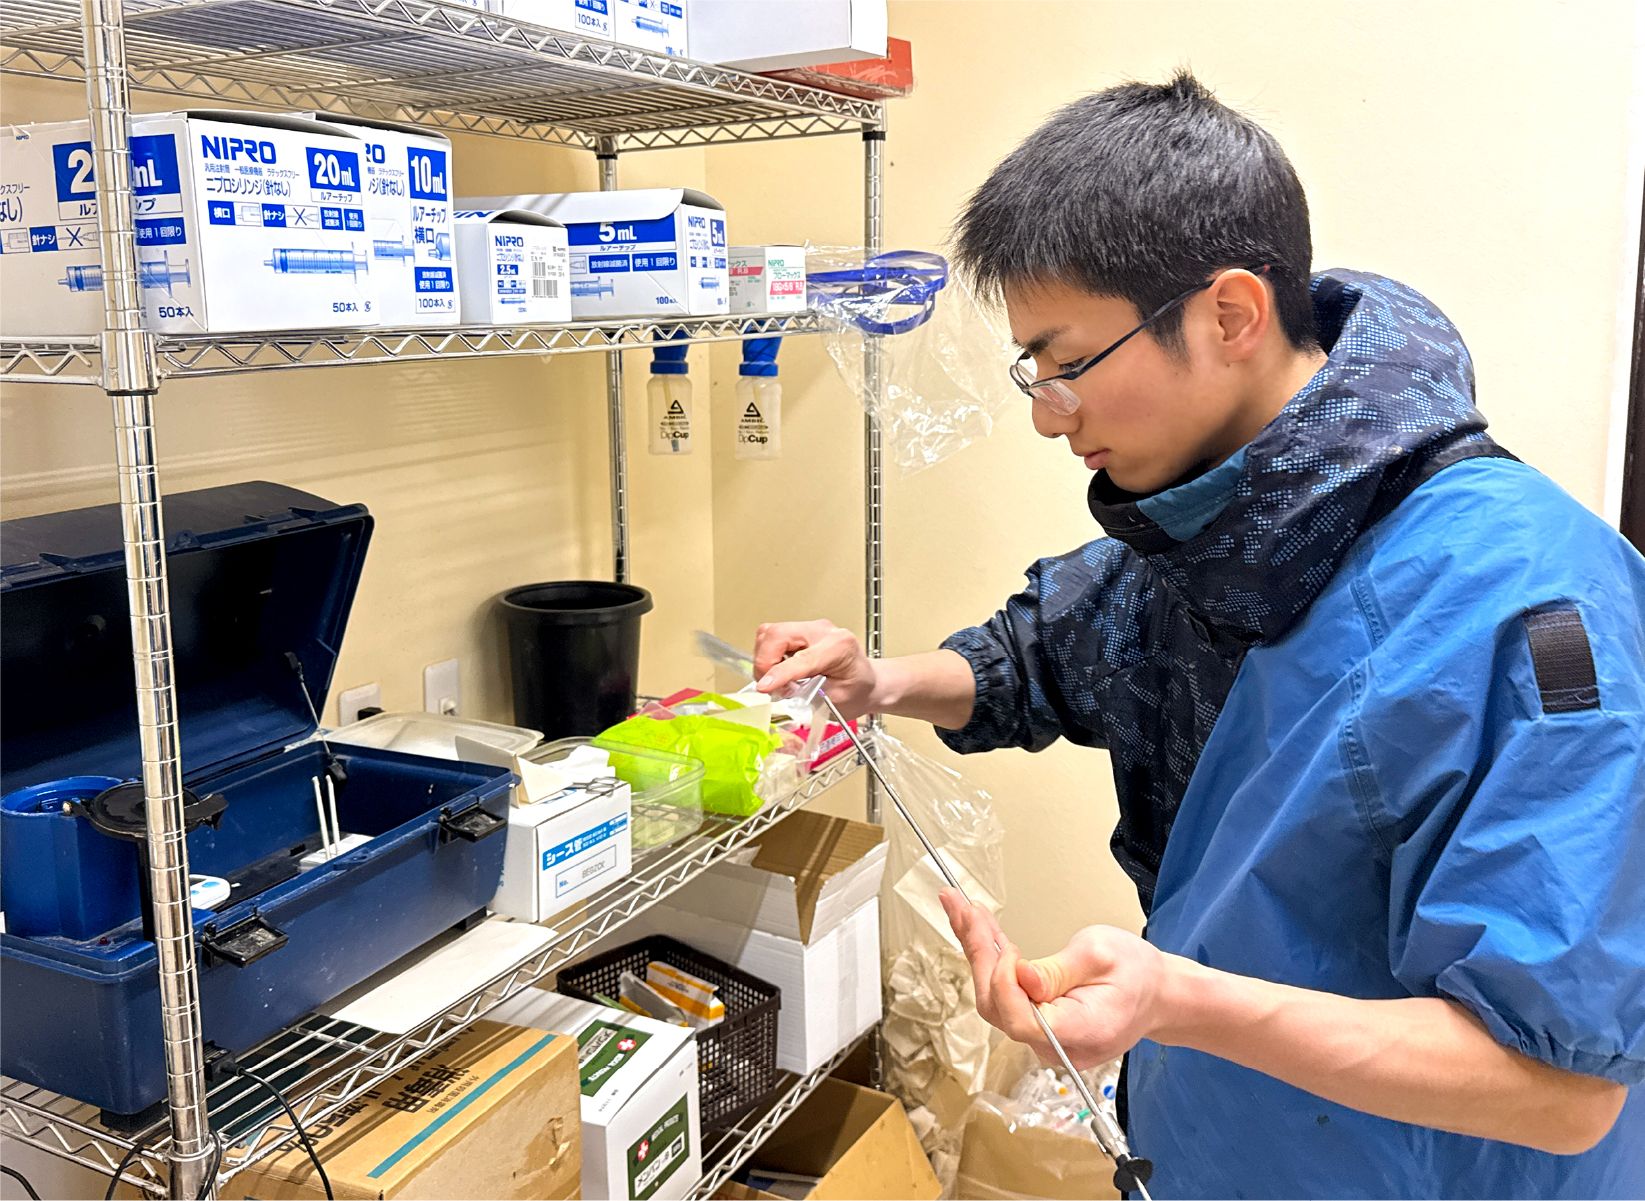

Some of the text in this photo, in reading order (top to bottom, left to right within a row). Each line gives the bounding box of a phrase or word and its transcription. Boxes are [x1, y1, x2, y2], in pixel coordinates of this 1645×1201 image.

[578, 13, 601, 28] 100本入
[201, 135, 277, 164] NIPRO
[314, 152, 355, 186] 20mL
[410, 155, 445, 194] 10mL
[207, 176, 290, 197] ニプロシリンジ(針なし)
[321, 192, 352, 202] ルアーチップ
[264, 210, 284, 220] 針ナシ
[413, 205, 446, 223] ルアーチップ
[688, 215, 705, 228] NIPRO
[32, 234, 55, 246] 針ナシ
[414, 226, 434, 244] 横口
[495, 236, 524, 247] NIPRO
[332, 302, 358, 313] 50本入
[419, 298, 445, 308] 100本入
[159, 306, 193, 318] 50本入
[382, 1065, 469, 1113] 消毒用
